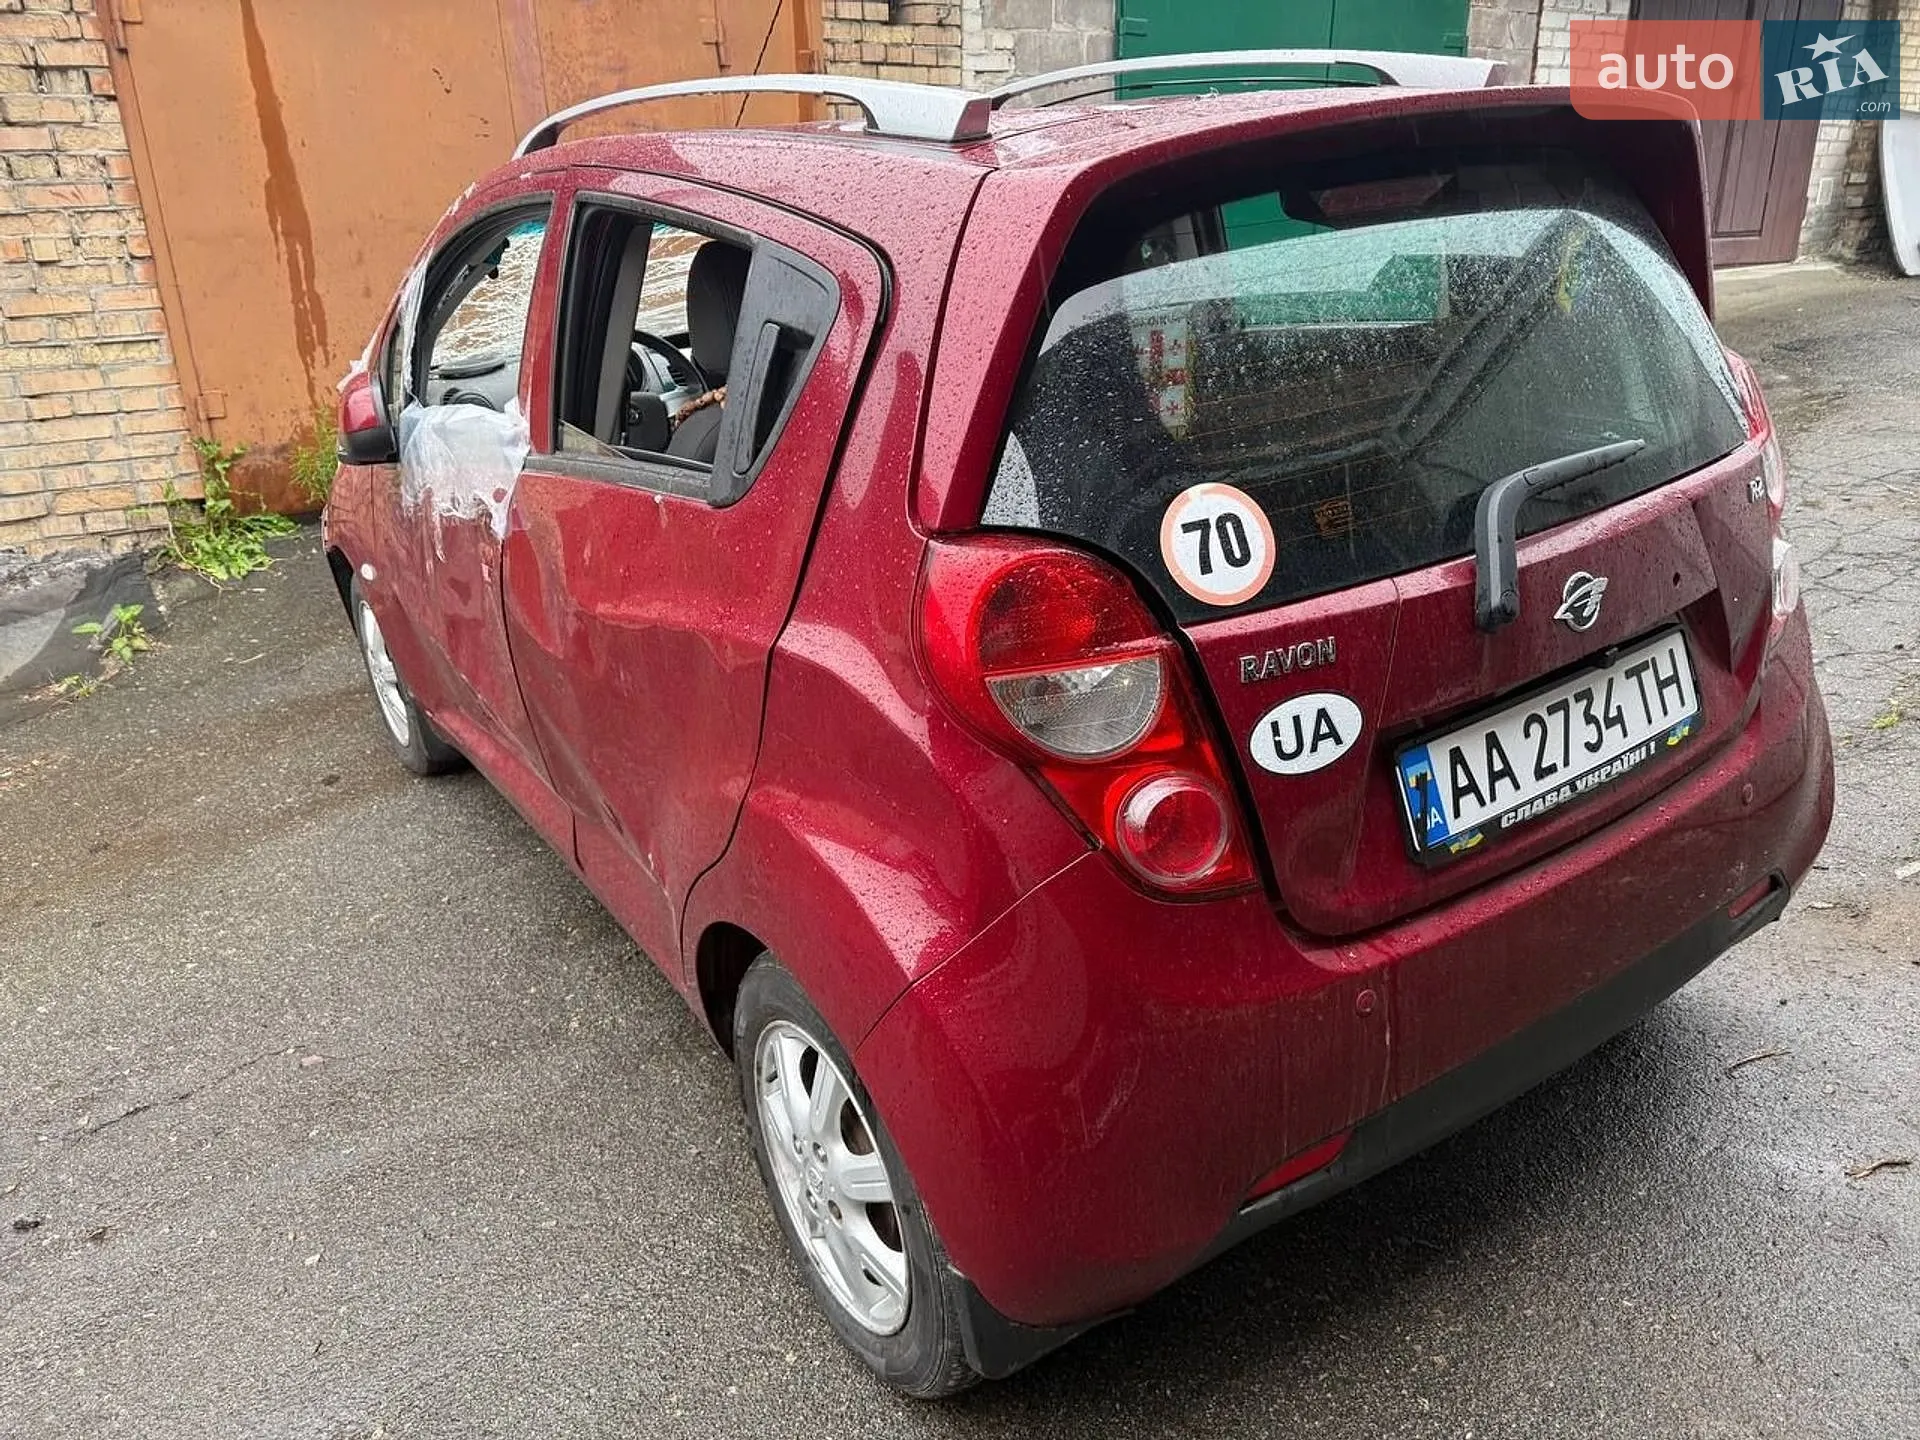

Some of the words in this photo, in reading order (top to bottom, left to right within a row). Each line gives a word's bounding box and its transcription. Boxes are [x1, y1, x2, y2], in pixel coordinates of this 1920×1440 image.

[1181, 511, 1252, 576] 70
[1240, 636, 1337, 684] RAVON
[1271, 707, 1344, 761] UA
[1449, 731, 1520, 818] AA
[1524, 678, 1628, 781] 2734
[1625, 648, 1686, 725] TH
[1501, 783, 1574, 829] СЛАВА
